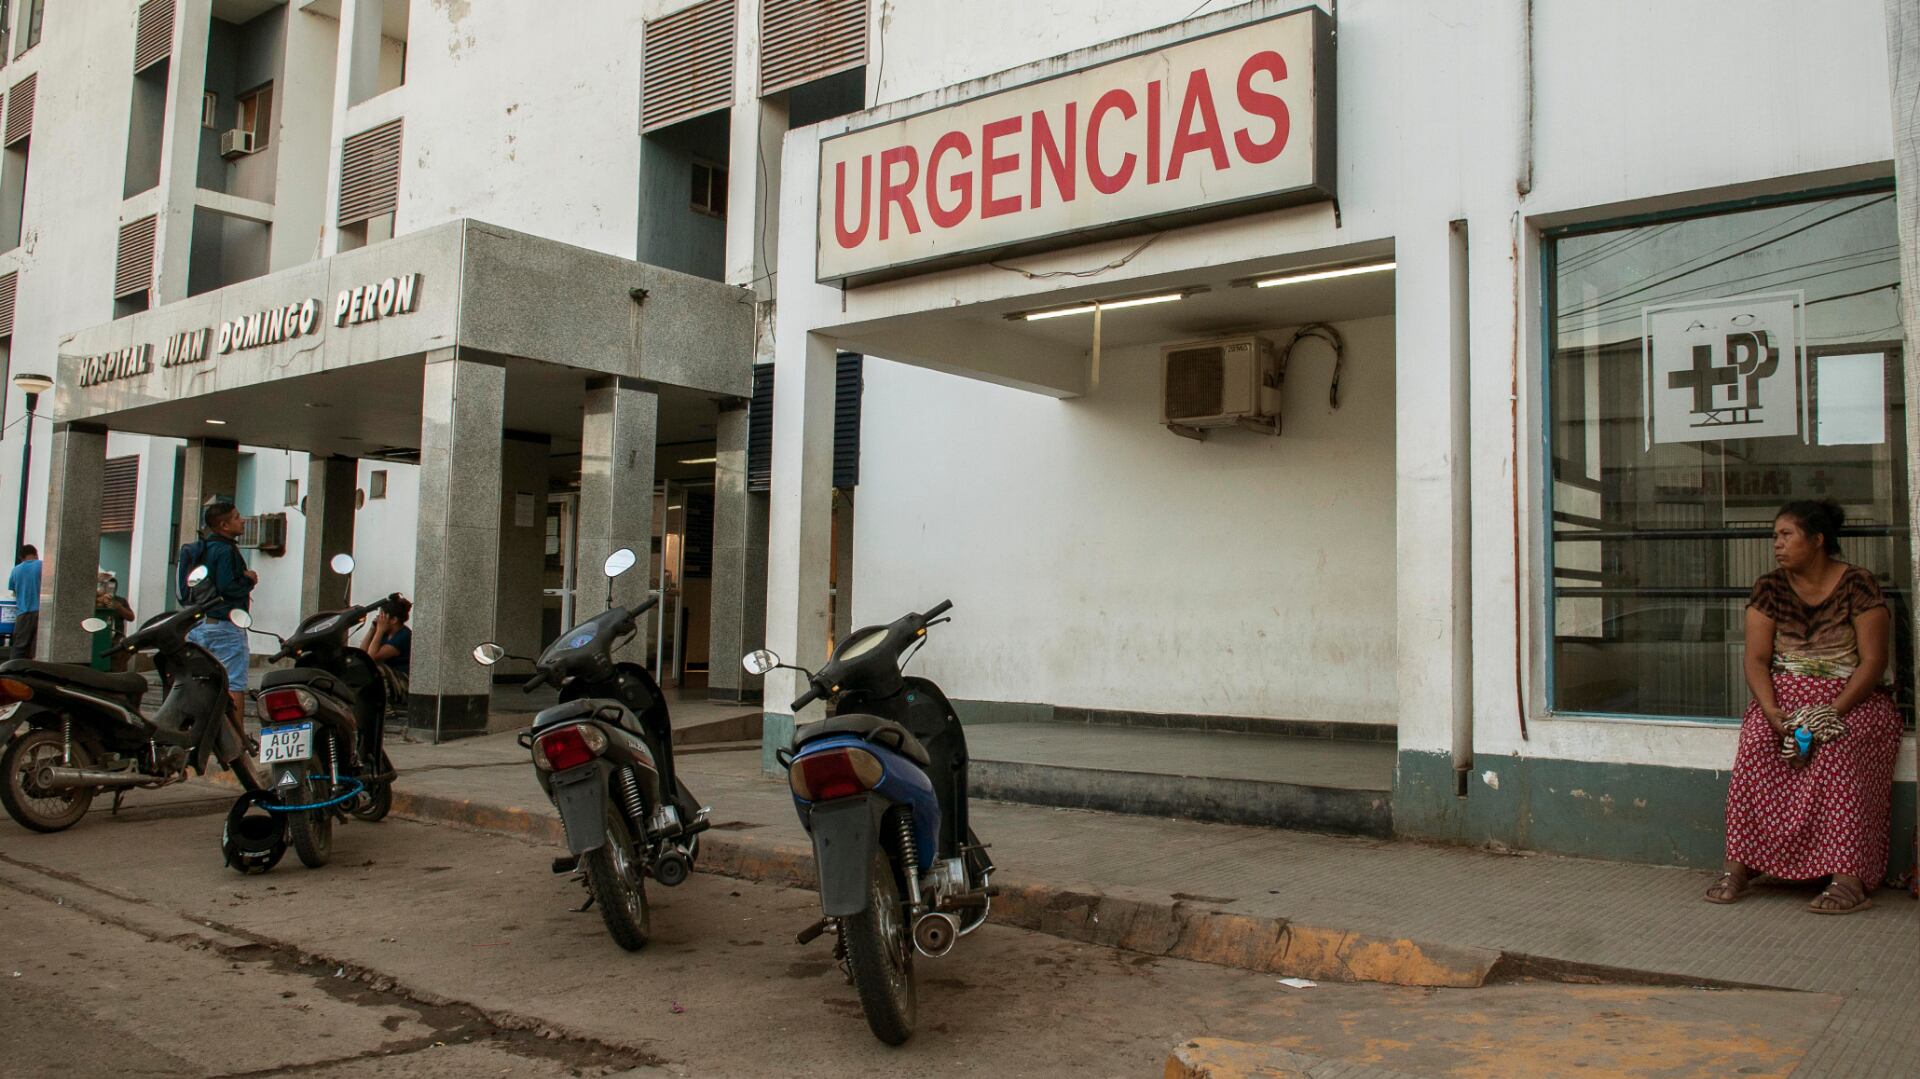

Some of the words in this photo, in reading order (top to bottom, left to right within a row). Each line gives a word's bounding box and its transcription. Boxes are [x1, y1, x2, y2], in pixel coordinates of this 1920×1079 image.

[835, 51, 1290, 249] URGENCIAS
[79, 343, 152, 387] HOSPITAL
[161, 327, 212, 368] JUAN
[218, 298, 323, 354] DOMINGO
[334, 272, 423, 328] PERON
[266, 744, 306, 761] 9LVF
[271, 731, 299, 747] A09
